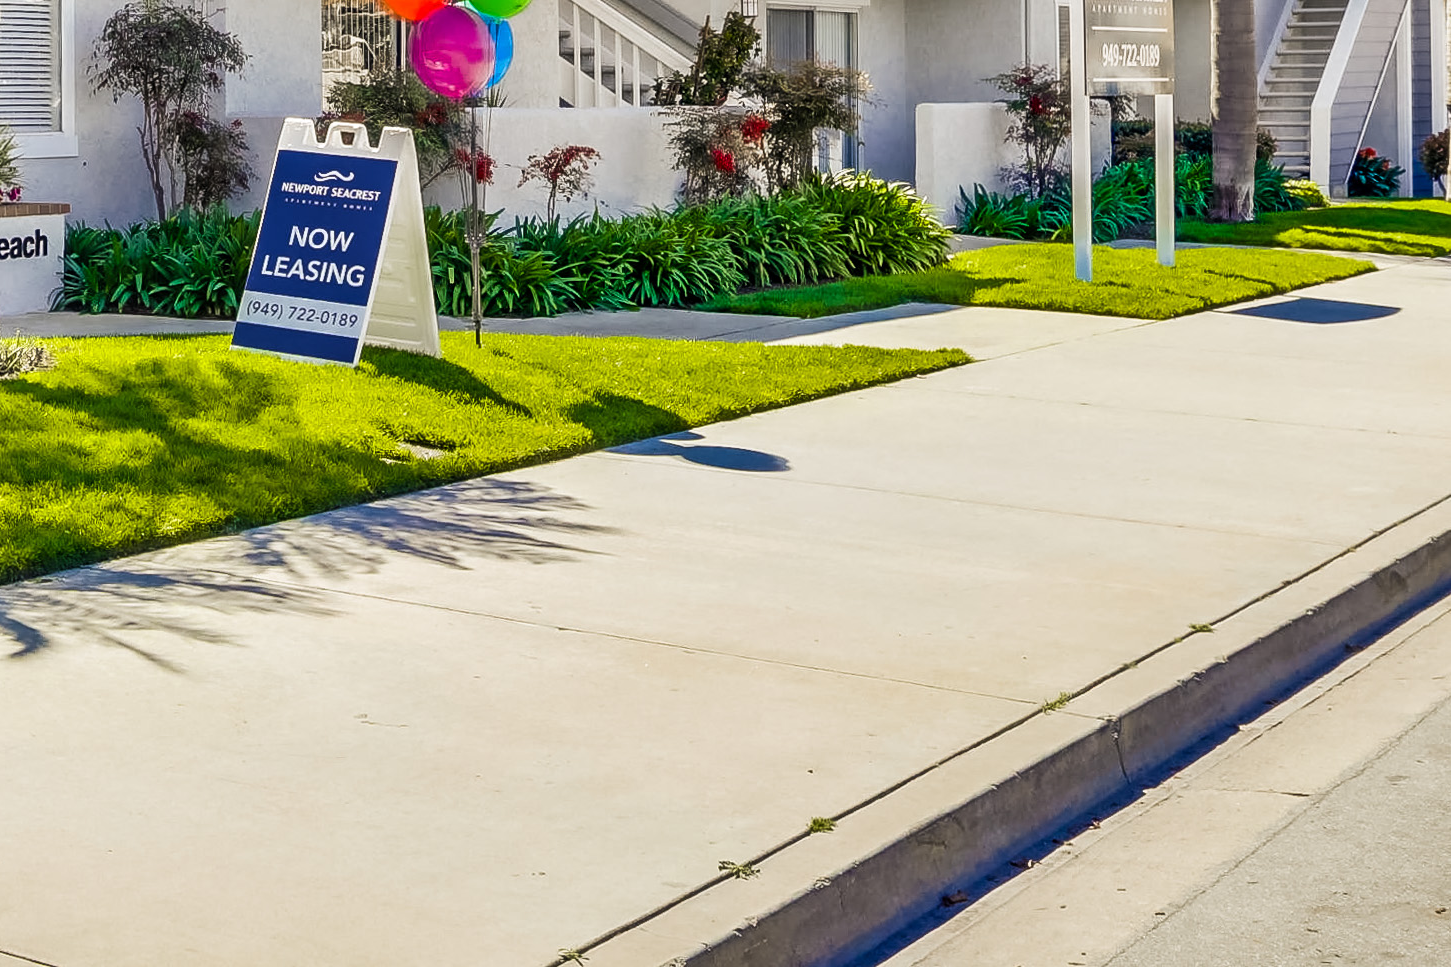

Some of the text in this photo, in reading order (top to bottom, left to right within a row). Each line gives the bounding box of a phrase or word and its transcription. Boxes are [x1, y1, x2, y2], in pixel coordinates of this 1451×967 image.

[1102, 43, 1160, 67] 949-722-0189
[281, 182, 381, 202] NEWPORT SEACREST
[289, 225, 355, 253] NOW
[261, 254, 366, 288] LEASING
[247, 300, 359, 327] (949) 722-0189
